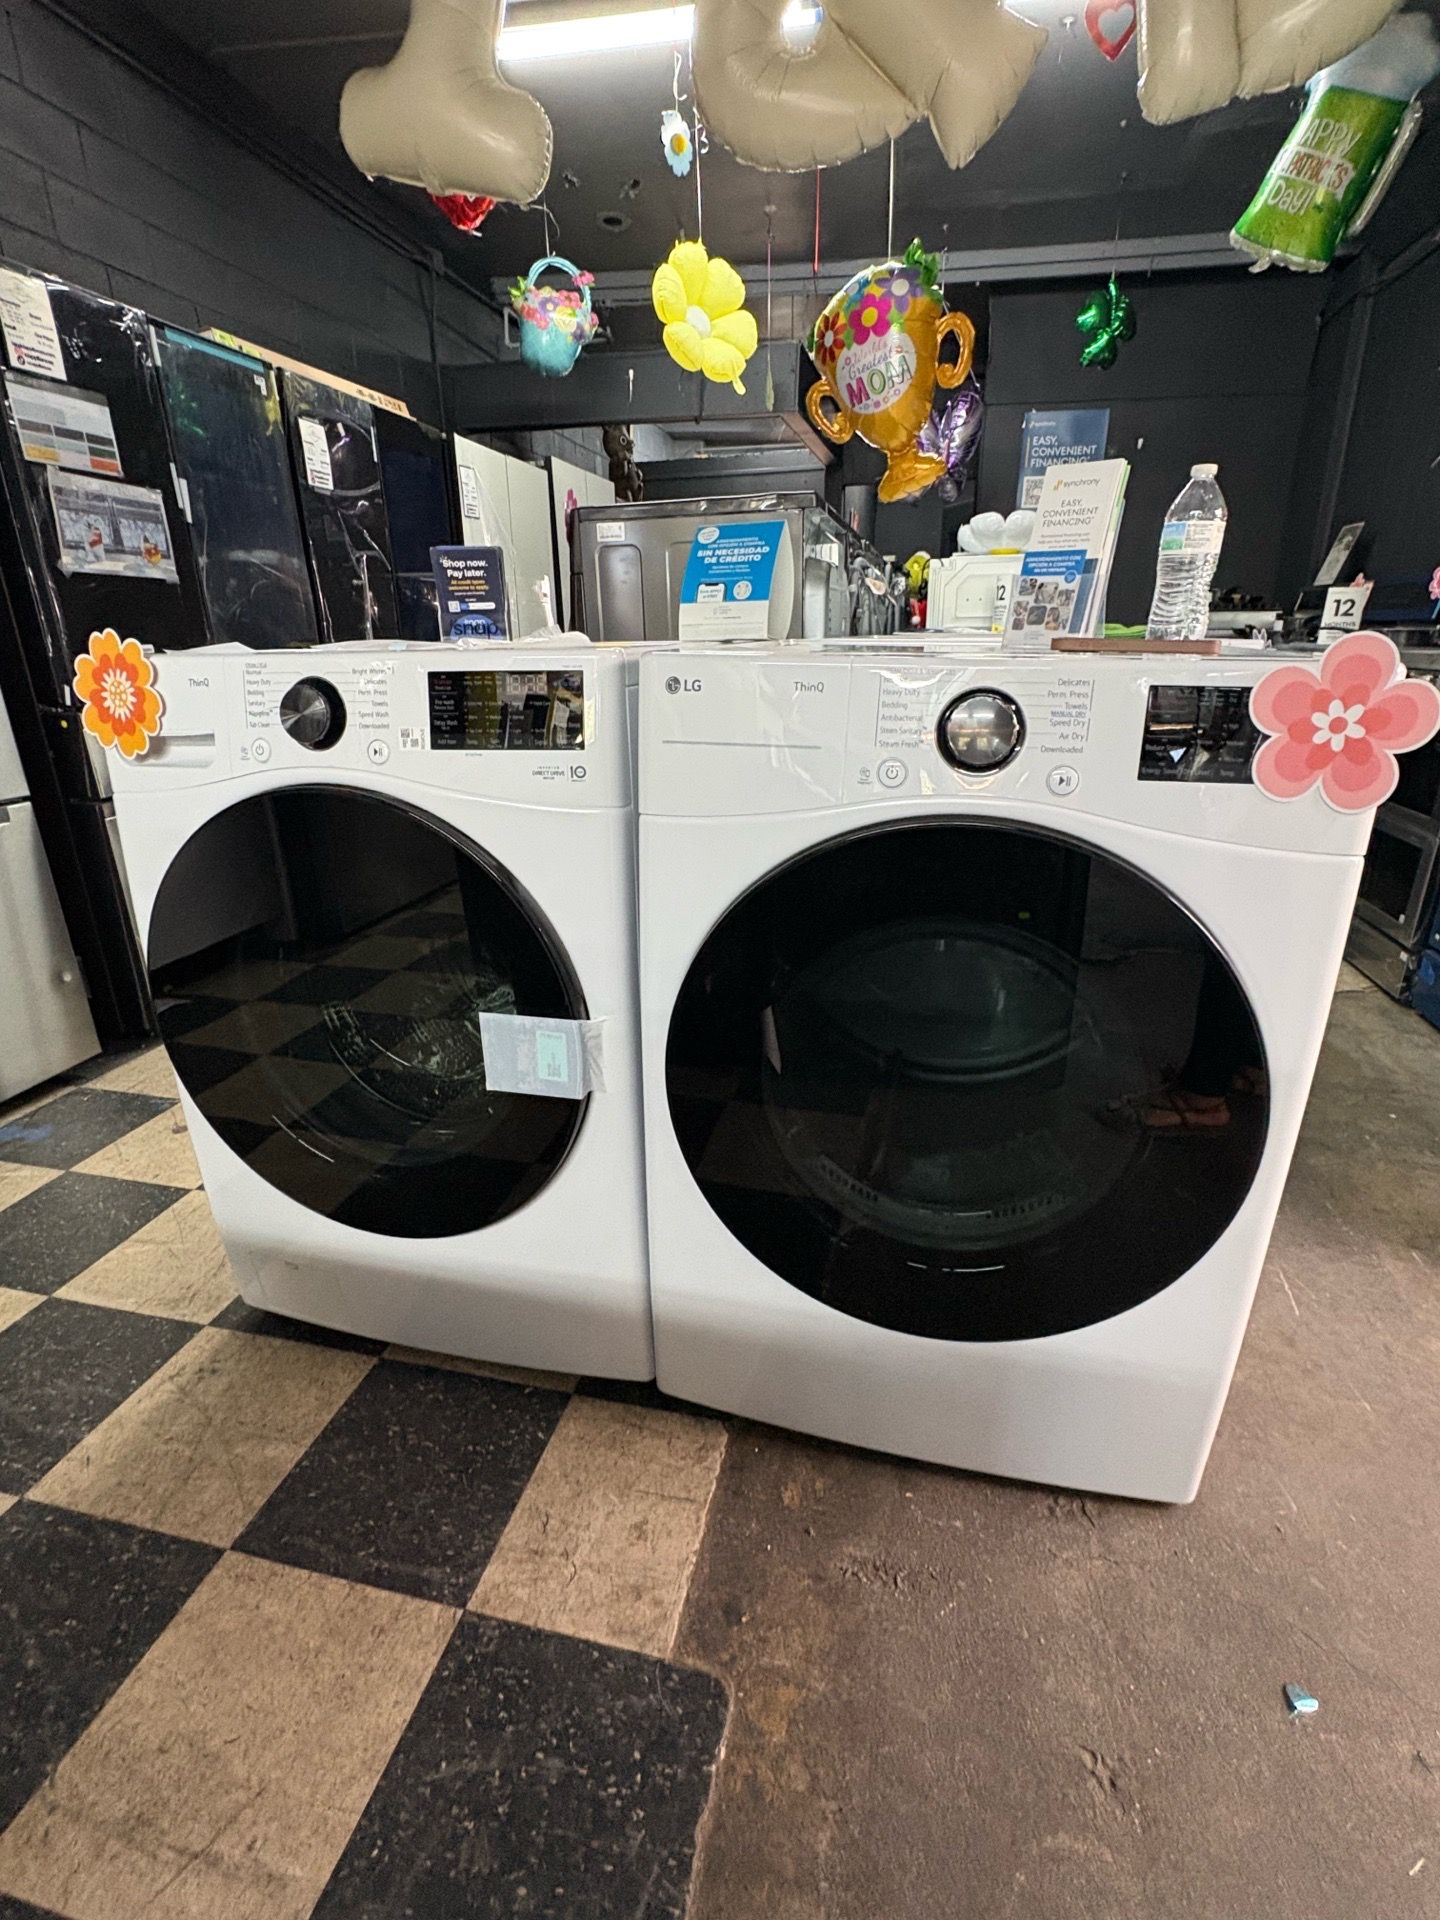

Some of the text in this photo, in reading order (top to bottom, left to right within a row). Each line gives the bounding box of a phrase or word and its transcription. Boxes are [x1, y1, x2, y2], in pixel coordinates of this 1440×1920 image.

[1031, 445, 1097, 457] CONVENIENT
[1042, 507, 1099, 518] CONVENIENT
[696, 546, 770, 557] SIN NECESIDAD
[443, 559, 466, 569] Shop
[703, 554, 762, 564] DE CRÉDITO
[447, 569, 487, 578] Pay later.
[1333, 598, 1356, 617] 12
[188, 678, 209, 688] ThinQ
[684, 679, 702, 692] LG
[793, 681, 825, 693] ThinQ
[1057, 679, 1090, 687] Delicates
[883, 688, 920, 697] Heavy Duty
[1069, 690, 1089, 698] Press
[881, 701, 908, 710] Bedding
[1065, 702, 1088, 710] Towels
[1050, 718, 1086, 728] Speed Dry
[1059, 732, 1084, 741] Air Dry
[1041, 744, 1084, 754] Downloaded
[570, 765, 587, 779] 10
